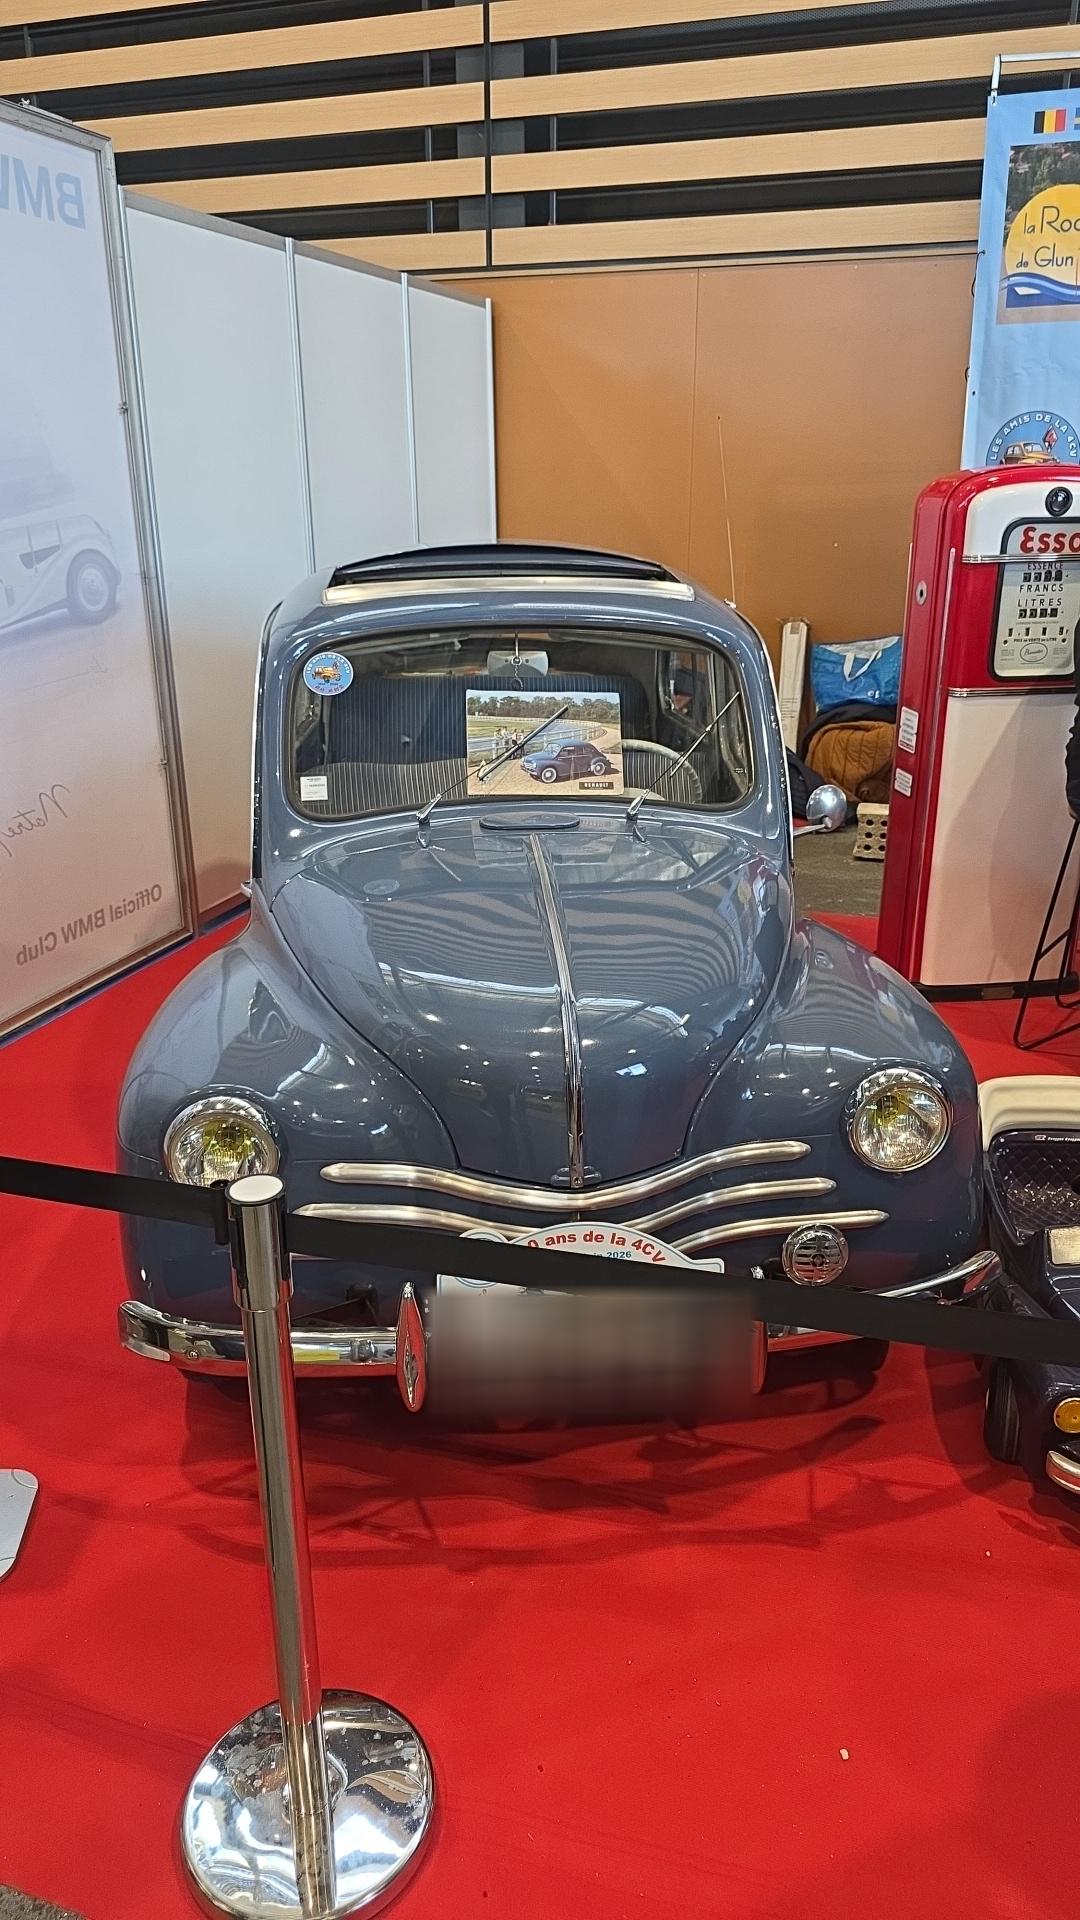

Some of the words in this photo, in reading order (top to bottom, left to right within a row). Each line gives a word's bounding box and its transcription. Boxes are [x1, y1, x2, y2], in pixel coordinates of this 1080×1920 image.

[1023, 212, 1036, 234] la
[1015, 251, 1029, 269] de
[1034, 242, 1074, 267] Glun
[990, 437, 1003, 461] LES
[1003, 414, 1031, 437] AMIS
[1035, 413, 1052, 423] DE
[1054, 419, 1068, 433] LA
[1066, 435, 1077, 457] 4CV
[1020, 526, 1080, 554] Esso
[1027, 561, 1064, 571] ESSENCE
[1019, 583, 1064, 593] FRANCS
[1017, 598, 1062, 608] LITRES
[545, 1233, 577, 1246] ans
[583, 1231, 604, 1243] de
[610, 1232, 626, 1246] la
[631, 1238, 666, 1262] 4CV
[606, 1251, 632, 1259] 2026
